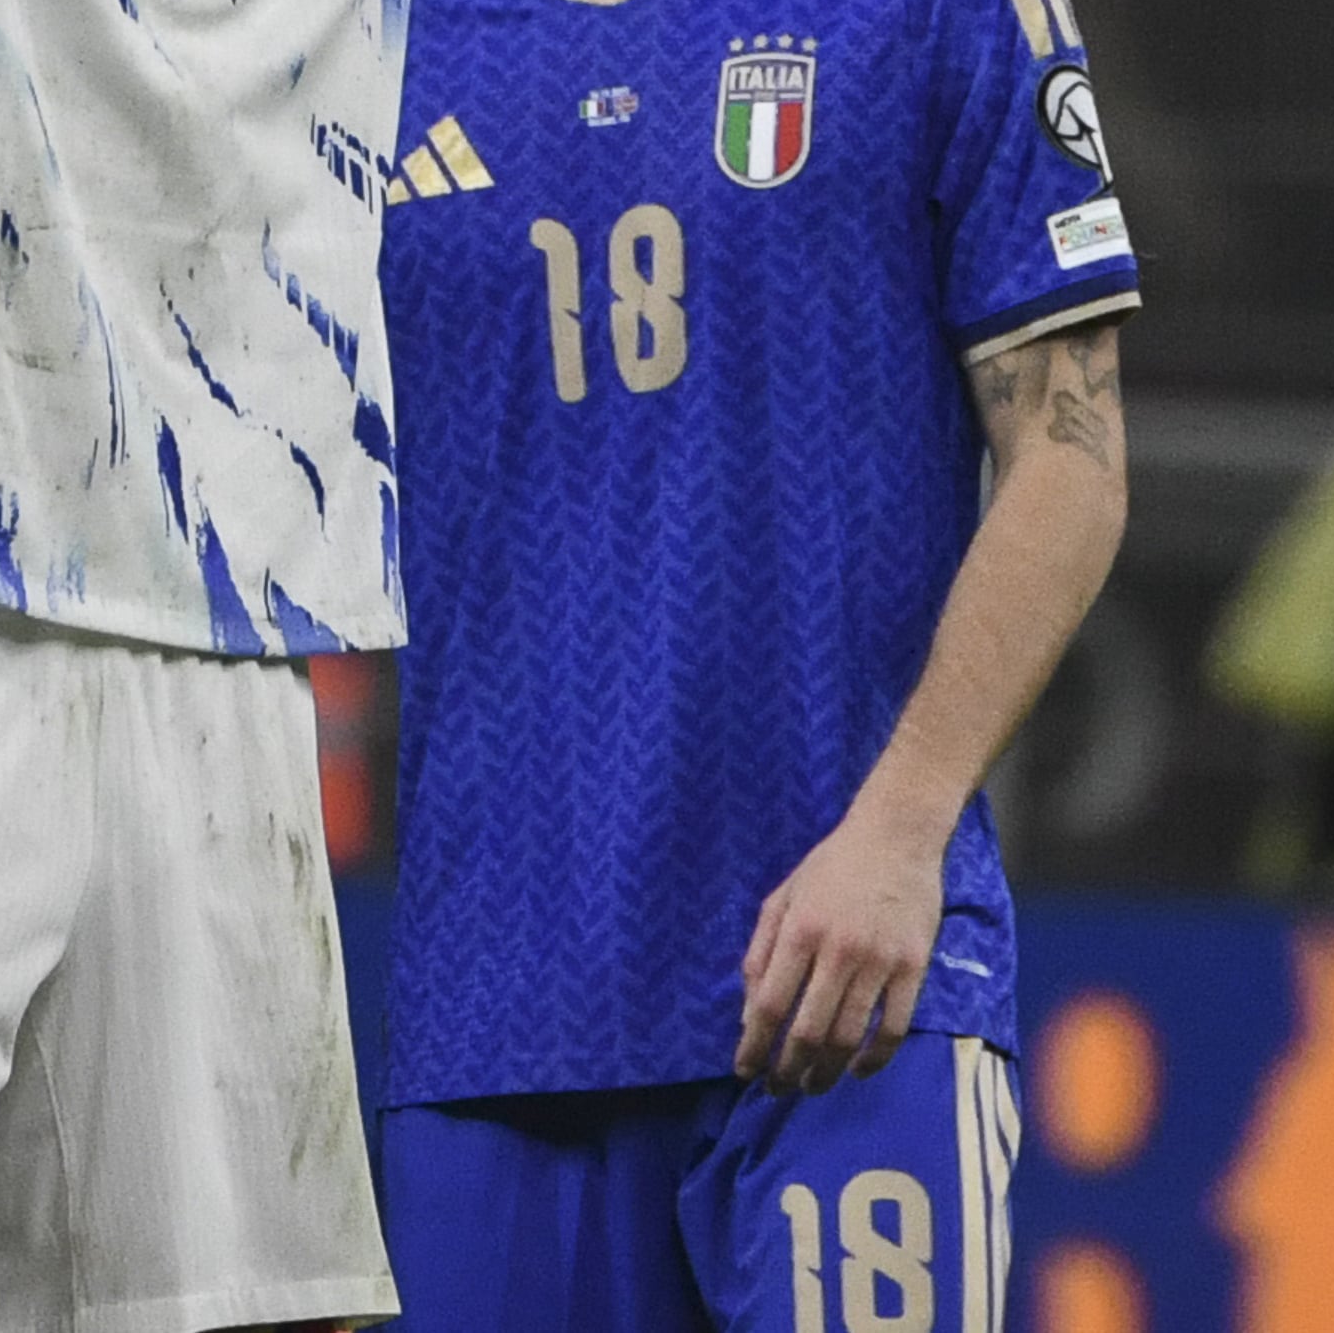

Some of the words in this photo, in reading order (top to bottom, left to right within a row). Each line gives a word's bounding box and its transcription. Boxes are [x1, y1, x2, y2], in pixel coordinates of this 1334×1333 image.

[729, 65, 804, 91] ITALIA
[529, 203, 688, 403] 18
[779, 1169, 936, 1333] 18
